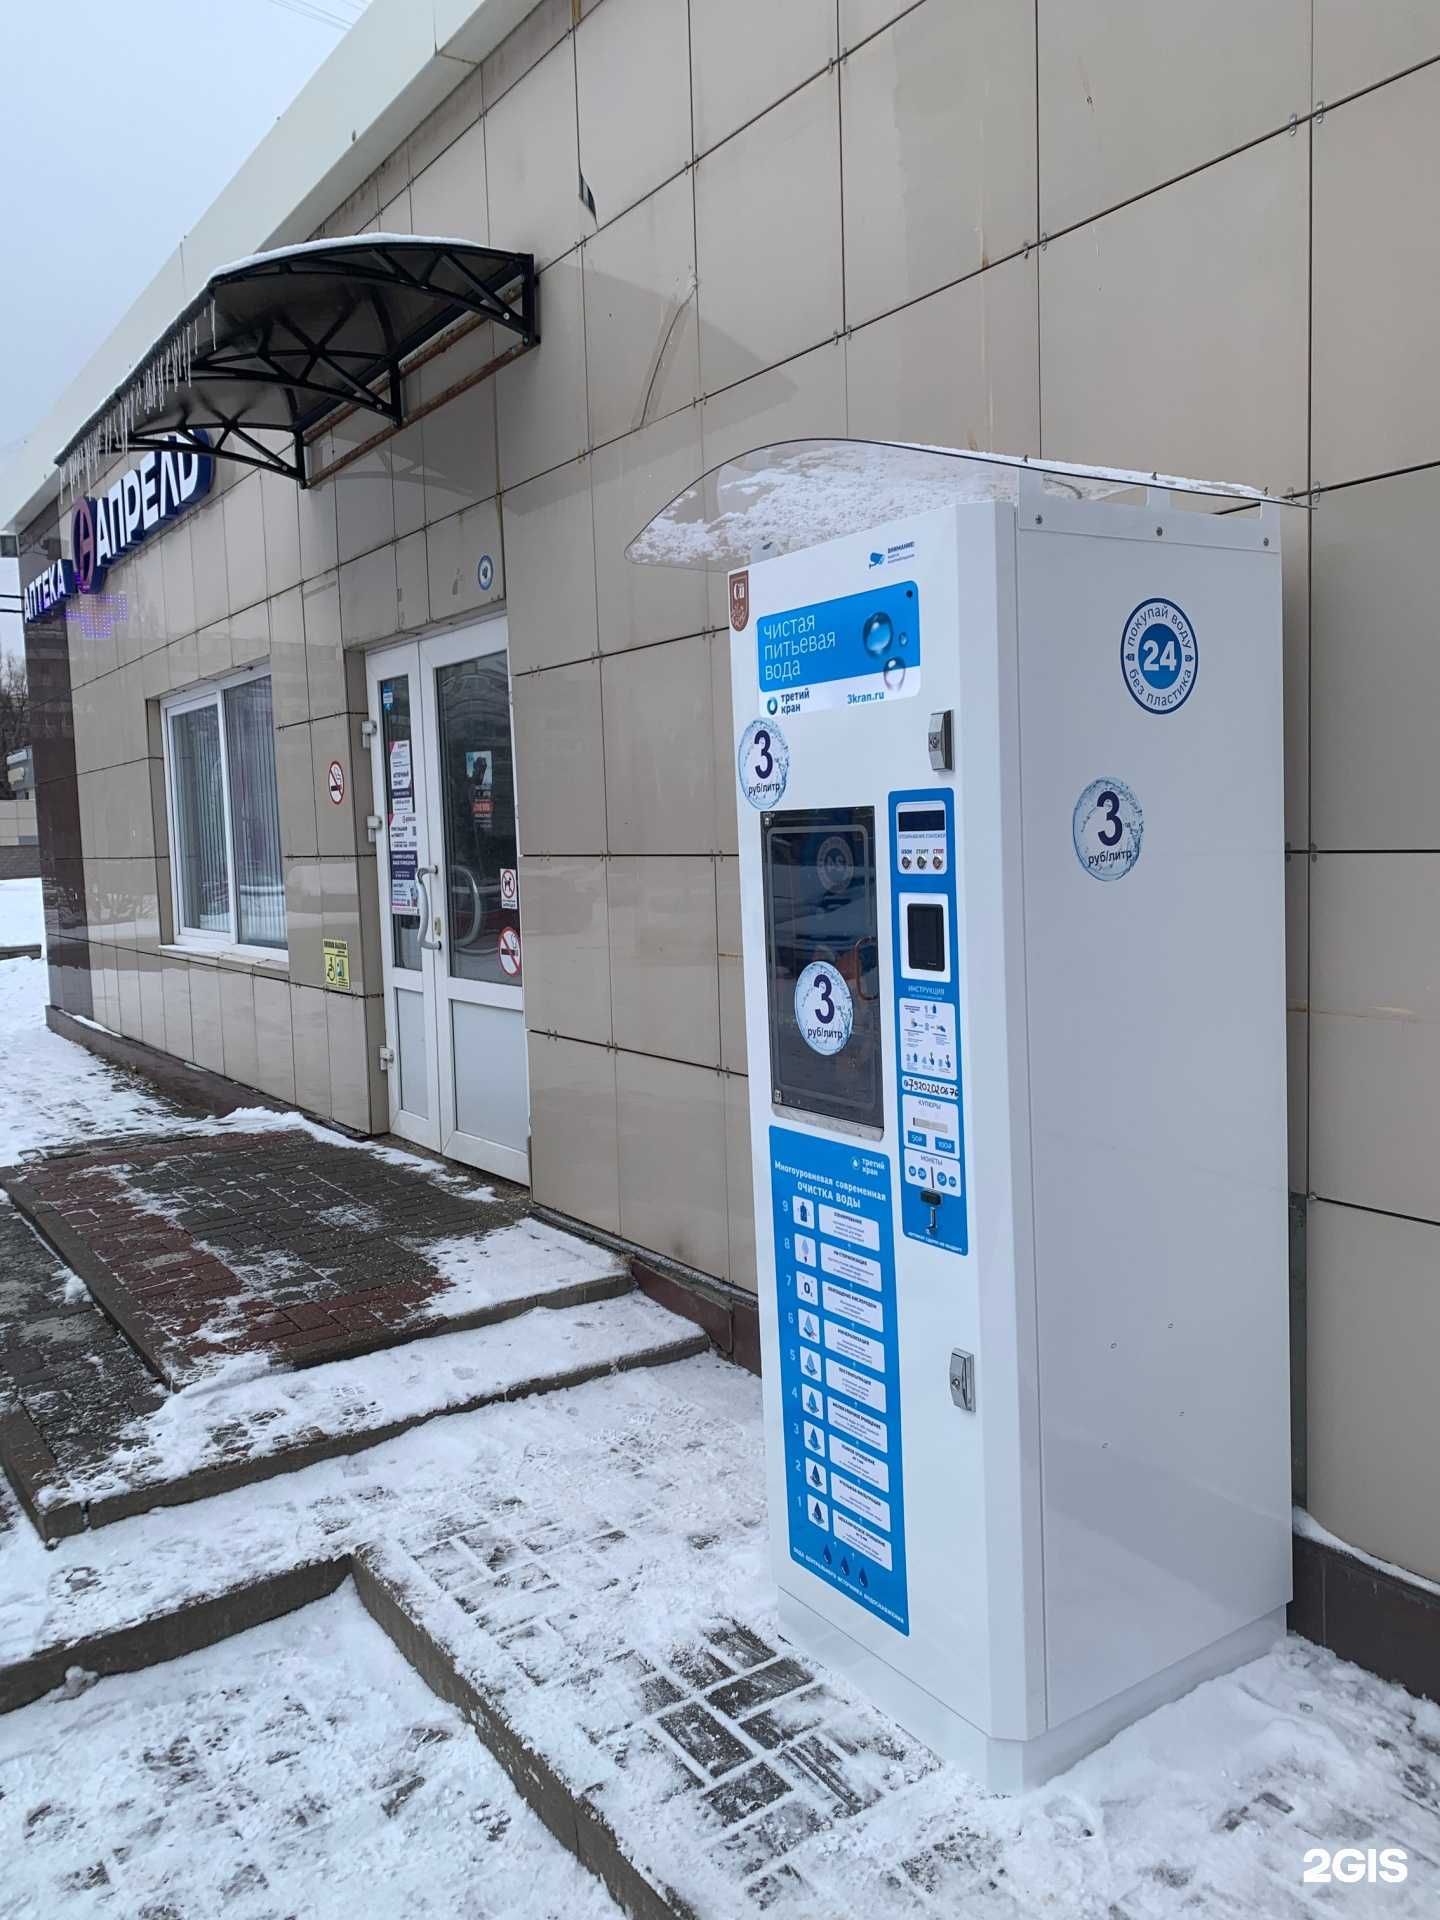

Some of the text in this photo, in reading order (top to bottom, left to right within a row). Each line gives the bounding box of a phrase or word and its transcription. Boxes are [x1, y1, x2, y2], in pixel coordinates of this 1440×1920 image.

[97, 429, 199, 566] АПРЕЛЬ
[24, 559, 67, 624] АПТЕКА
[764, 614, 815, 639] чистая
[1127, 605, 1192, 649] покупай воду
[764, 631, 836, 660] питьевая
[1142, 639, 1177, 671] 24
[765, 658, 800, 682] вода
[781, 688, 810, 702] третий
[847, 691, 884, 704] 3kran.ru
[1129, 668, 1192, 707] без пластика
[781, 703, 801, 714] кран
[754, 729, 774, 779] 3
[748, 781, 781, 795] руб/литр
[1096, 790, 1123, 846] 3
[1088, 849, 1132, 867] руб/литр
[813, 974, 835, 1024] 3
[807, 1027, 843, 1040] руб/литр
[862, 1158, 885, 1169] третий
[862, 1167, 878, 1176] кран
[775, 1160, 886, 1201] Многоуровневая современная
[797, 1181, 861, 1209] ОЧИСТКА ВОДЫ
